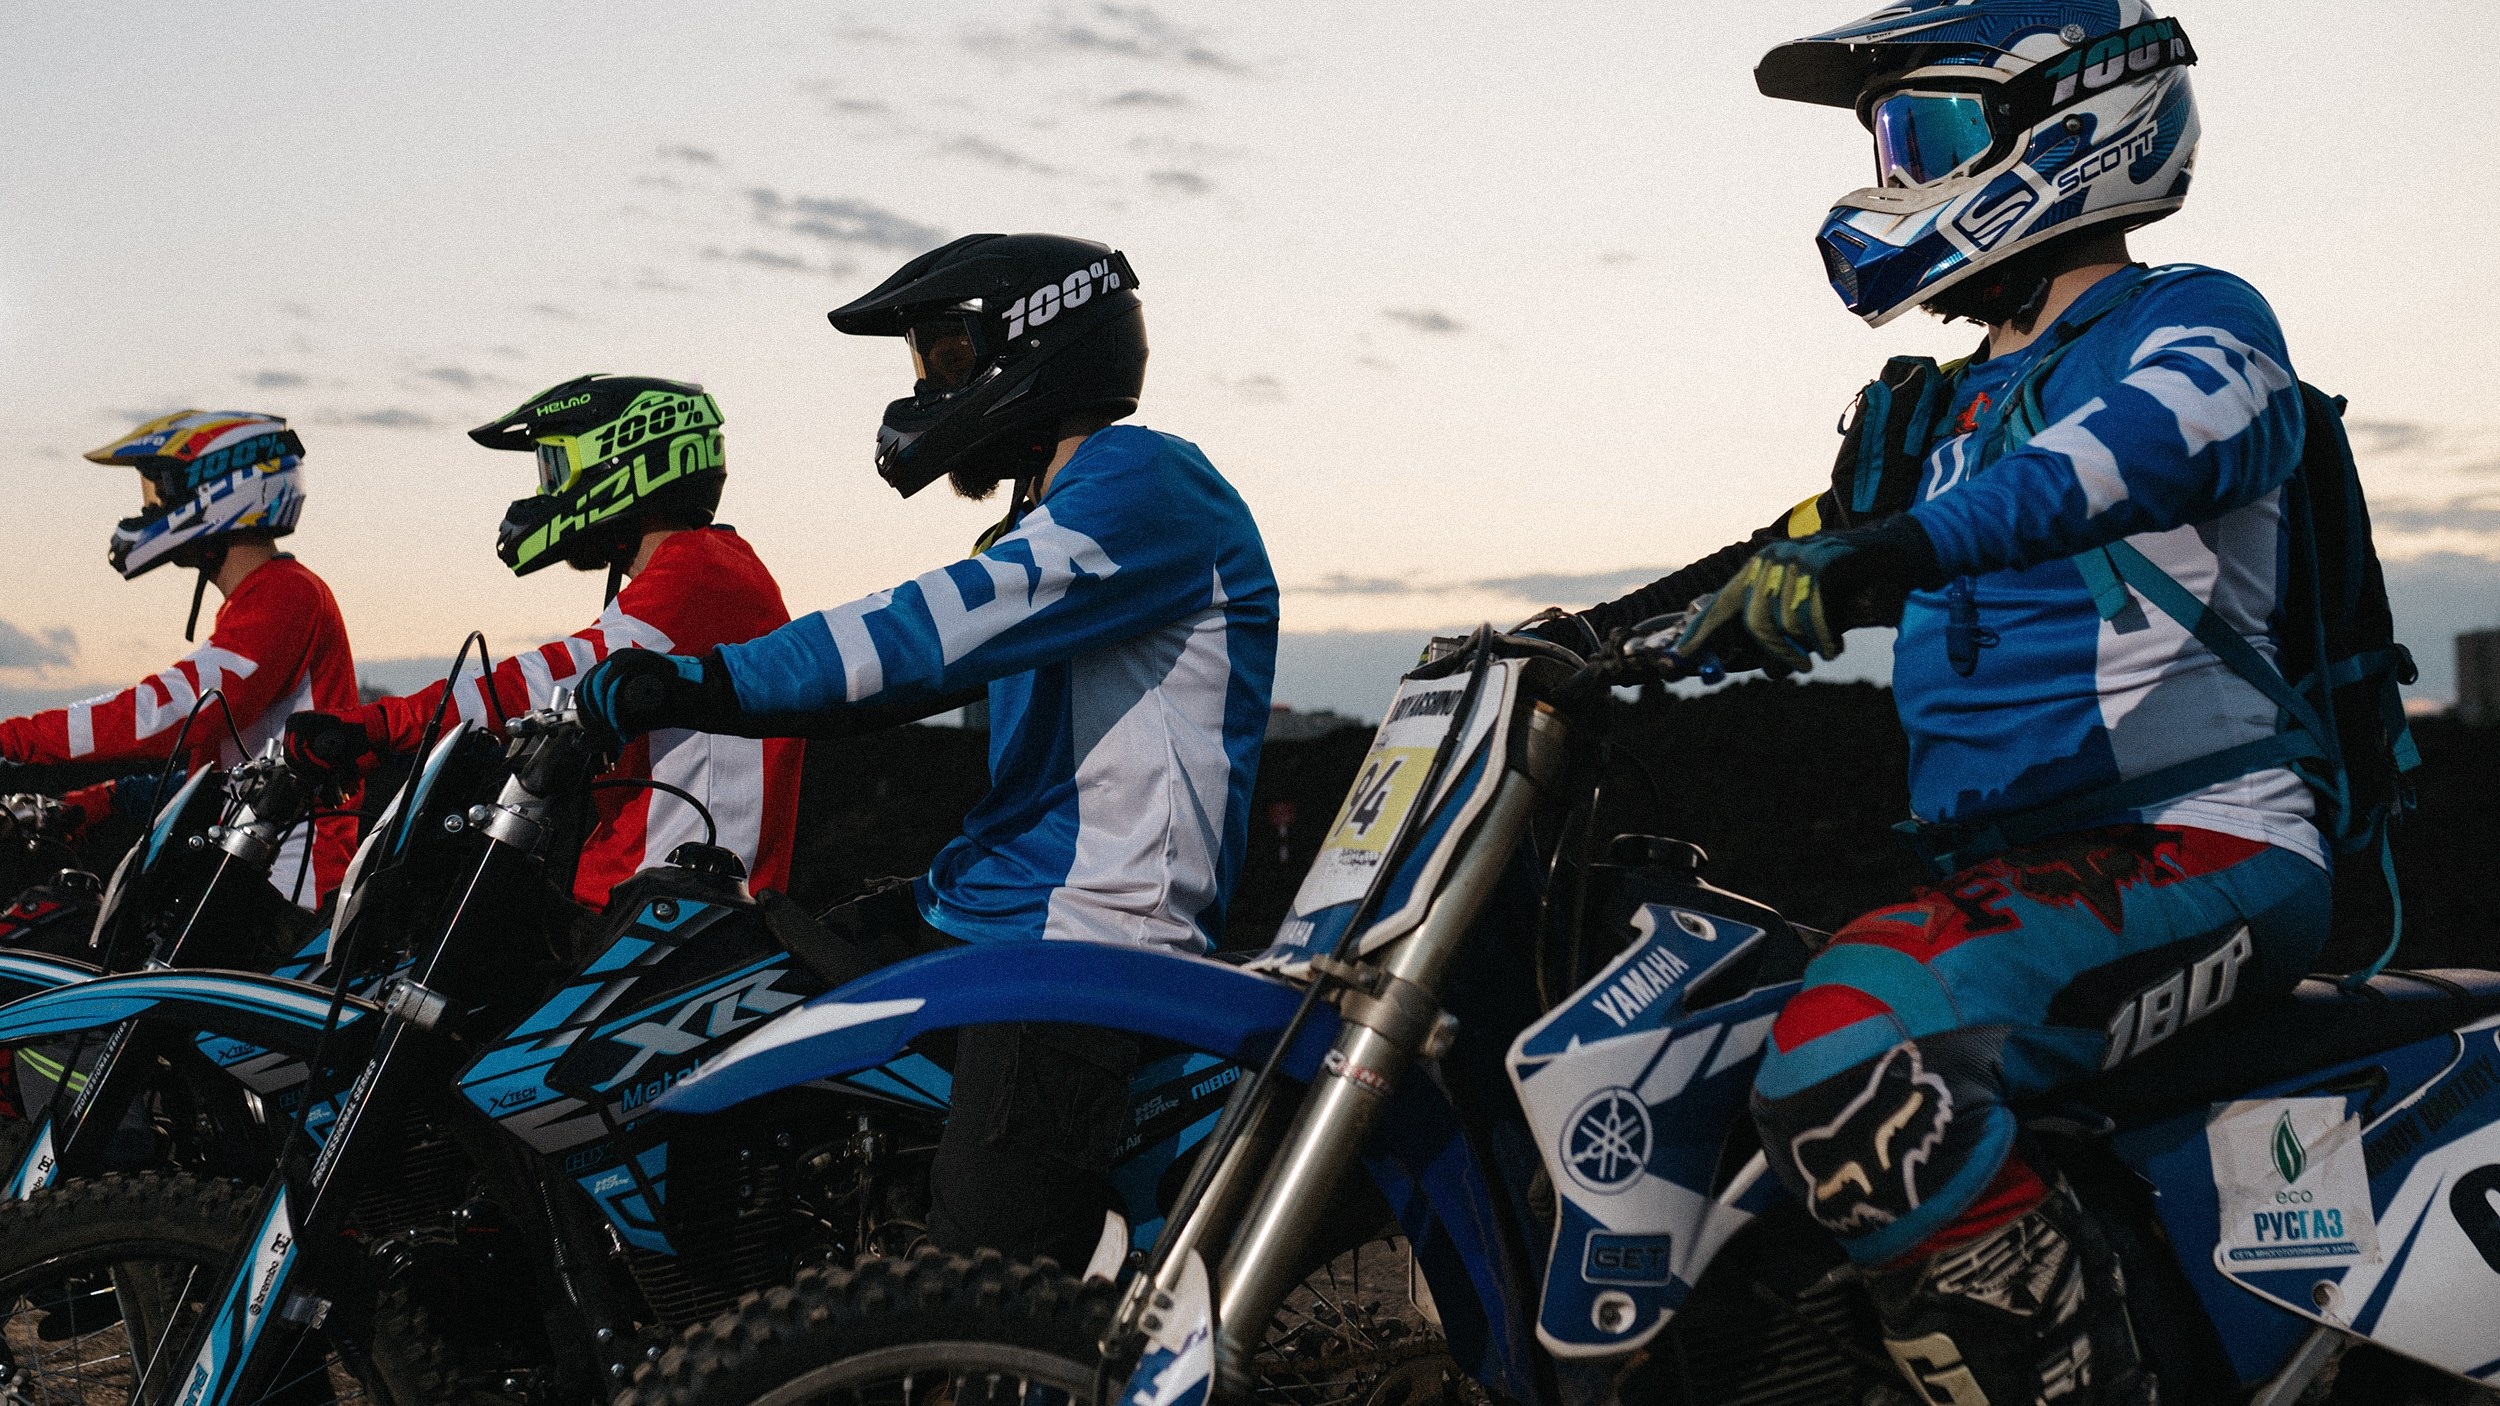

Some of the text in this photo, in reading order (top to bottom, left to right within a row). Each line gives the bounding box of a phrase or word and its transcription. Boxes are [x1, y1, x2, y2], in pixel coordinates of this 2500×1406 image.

[2044, 20, 2186, 106] 100%
[2057, 125, 2155, 196] SCOTT
[1001, 258, 1121, 341] 100%
[536, 393, 592, 417] HELMO
[595, 399, 703, 460] 100%
[184, 432, 288, 490] 100%
[1590, 944, 1691, 1029] YAMAHA
[311, 1101, 358, 1188] PROFESSIONAL
[353, 1058, 378, 1102] SERIES
[2253, 1208, 2344, 1241] РУСГАЗ
[2275, 1190, 2313, 1204] eco
[256, 1260, 279, 1303] brembo
